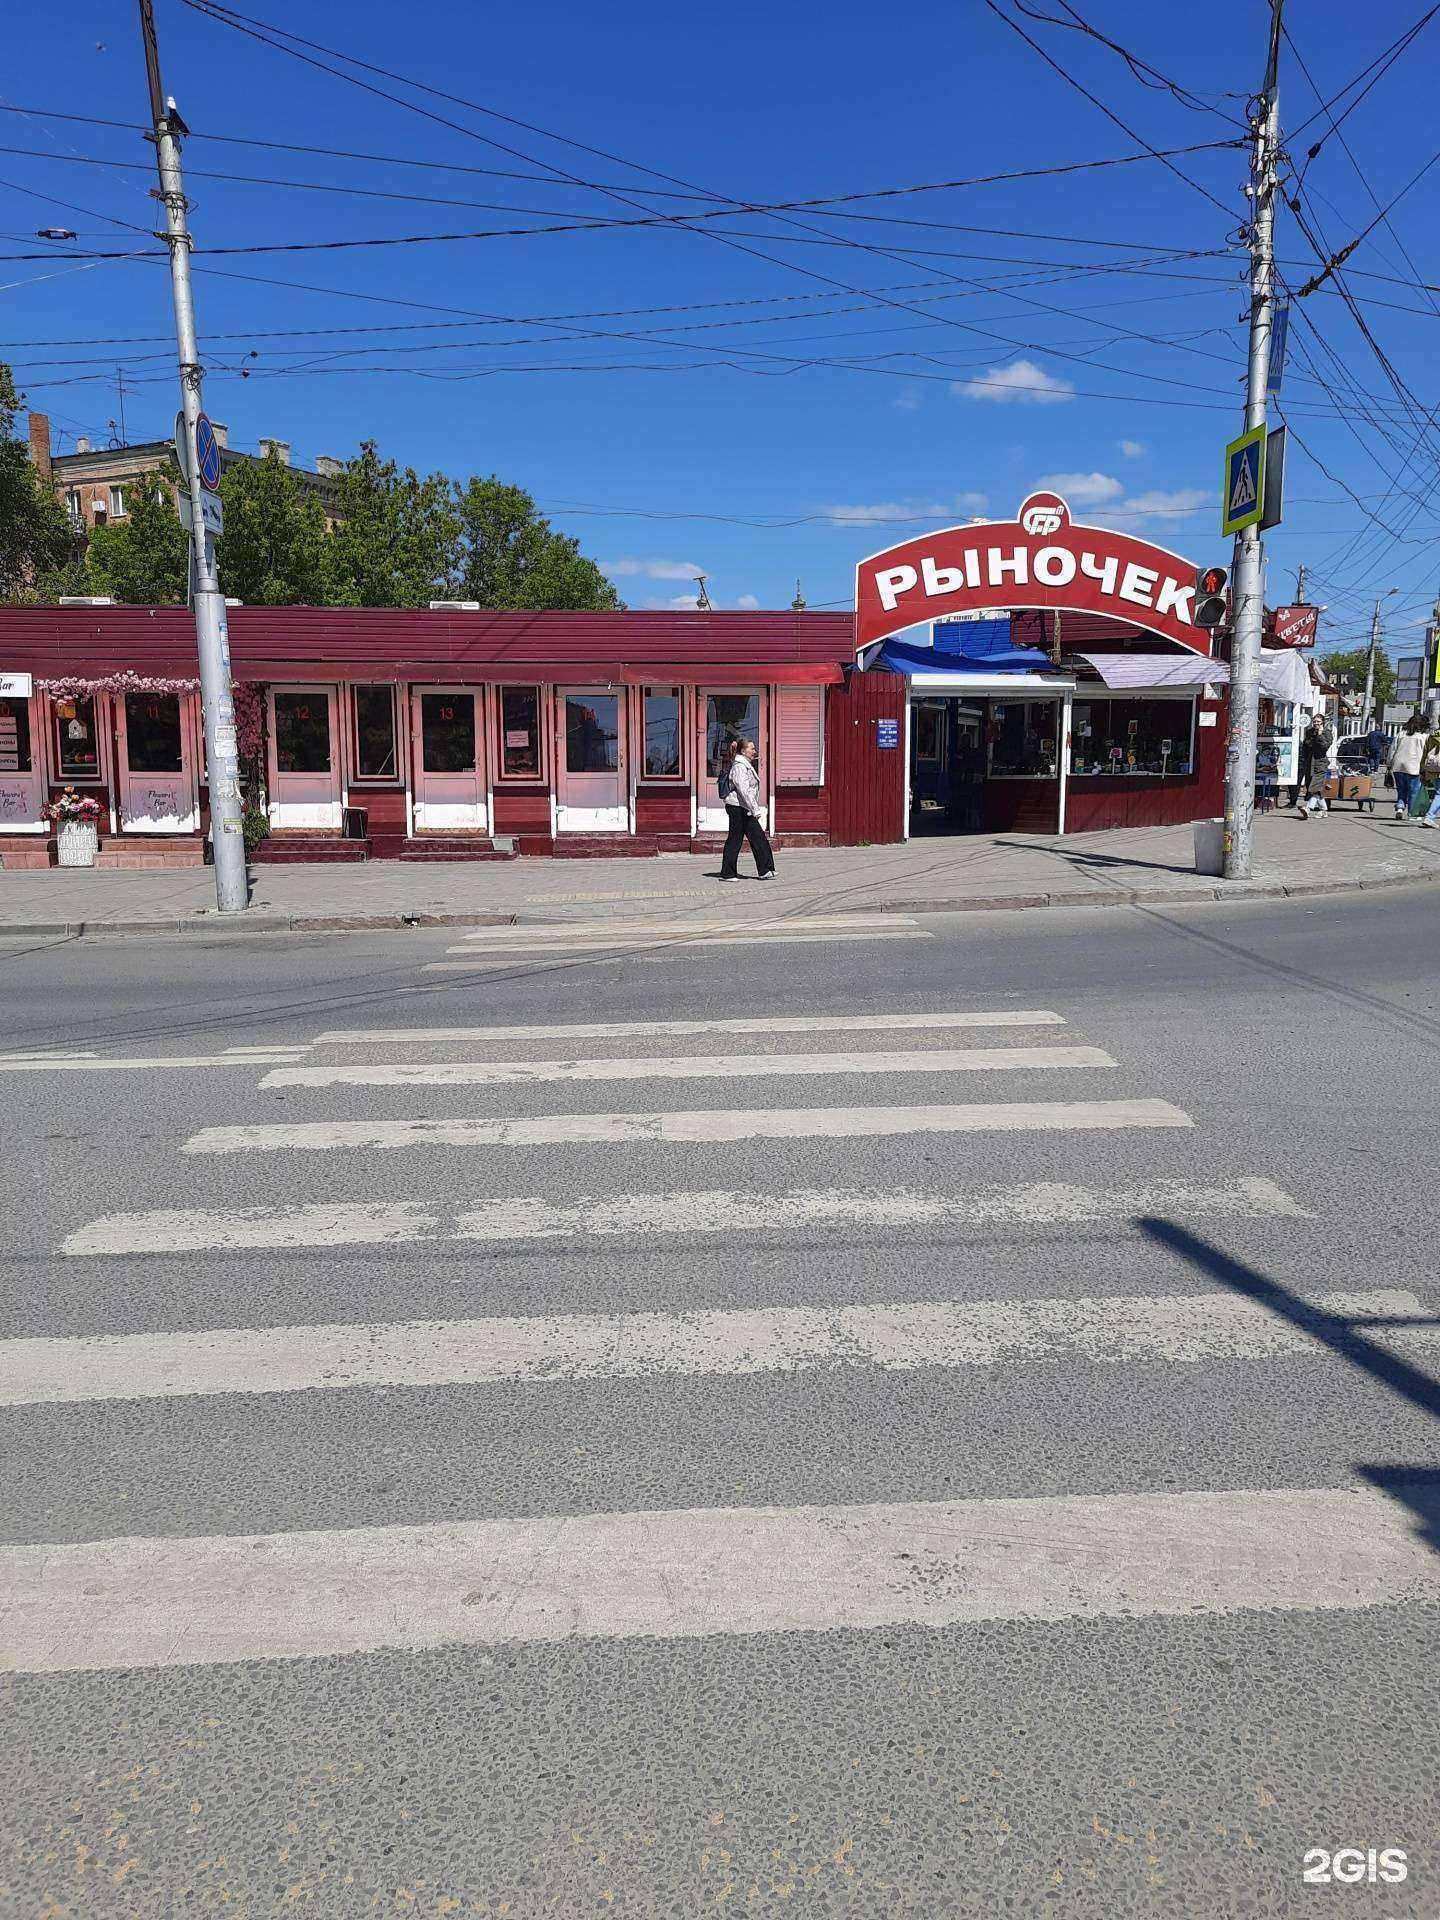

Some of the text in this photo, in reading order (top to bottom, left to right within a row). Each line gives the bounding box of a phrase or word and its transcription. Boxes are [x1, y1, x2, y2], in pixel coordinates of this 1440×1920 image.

[875, 546, 1195, 625] РЫНОЧЕК
[1277, 612, 1315, 640] ЦВЕТЫ
[1293, 634, 1309, 645] 24
[297, 705, 310, 719] 12
[440, 706, 454, 720] 13
